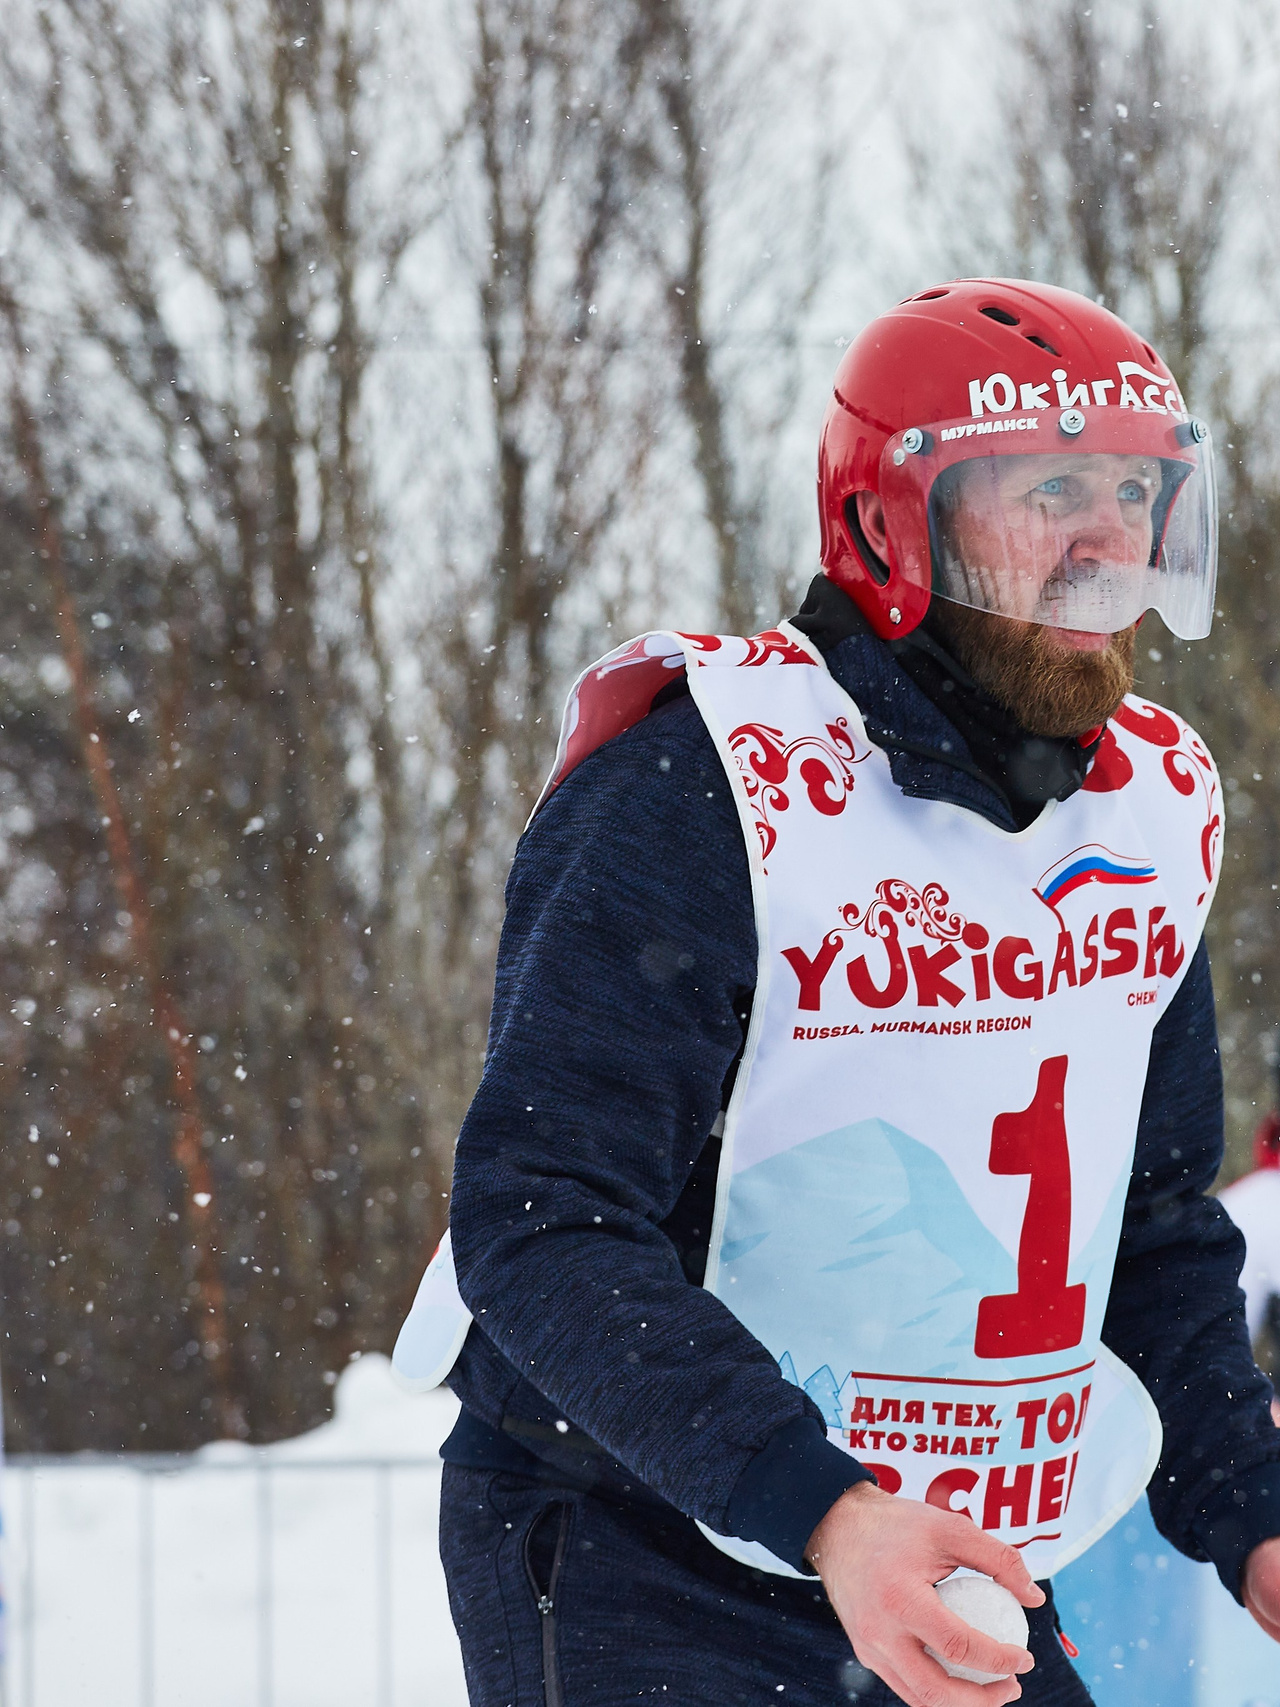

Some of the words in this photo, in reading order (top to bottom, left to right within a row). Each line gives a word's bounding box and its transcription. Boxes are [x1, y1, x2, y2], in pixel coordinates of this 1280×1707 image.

[940, 417, 1039, 442] МУРМАНСК
[869, 1020, 972, 1036] MURMANSK
[976, 1015, 1033, 1034] REGION
[973, 1054, 1087, 1359] 1
[850, 1396, 925, 1425] ДЛЯ
[931, 1402, 1002, 1430] ТЕХ,
[849, 1430, 908, 1452] КТО
[912, 1433, 1001, 1456] ЗНАЕТ
[925, 1450, 1079, 1530] СНЕ
